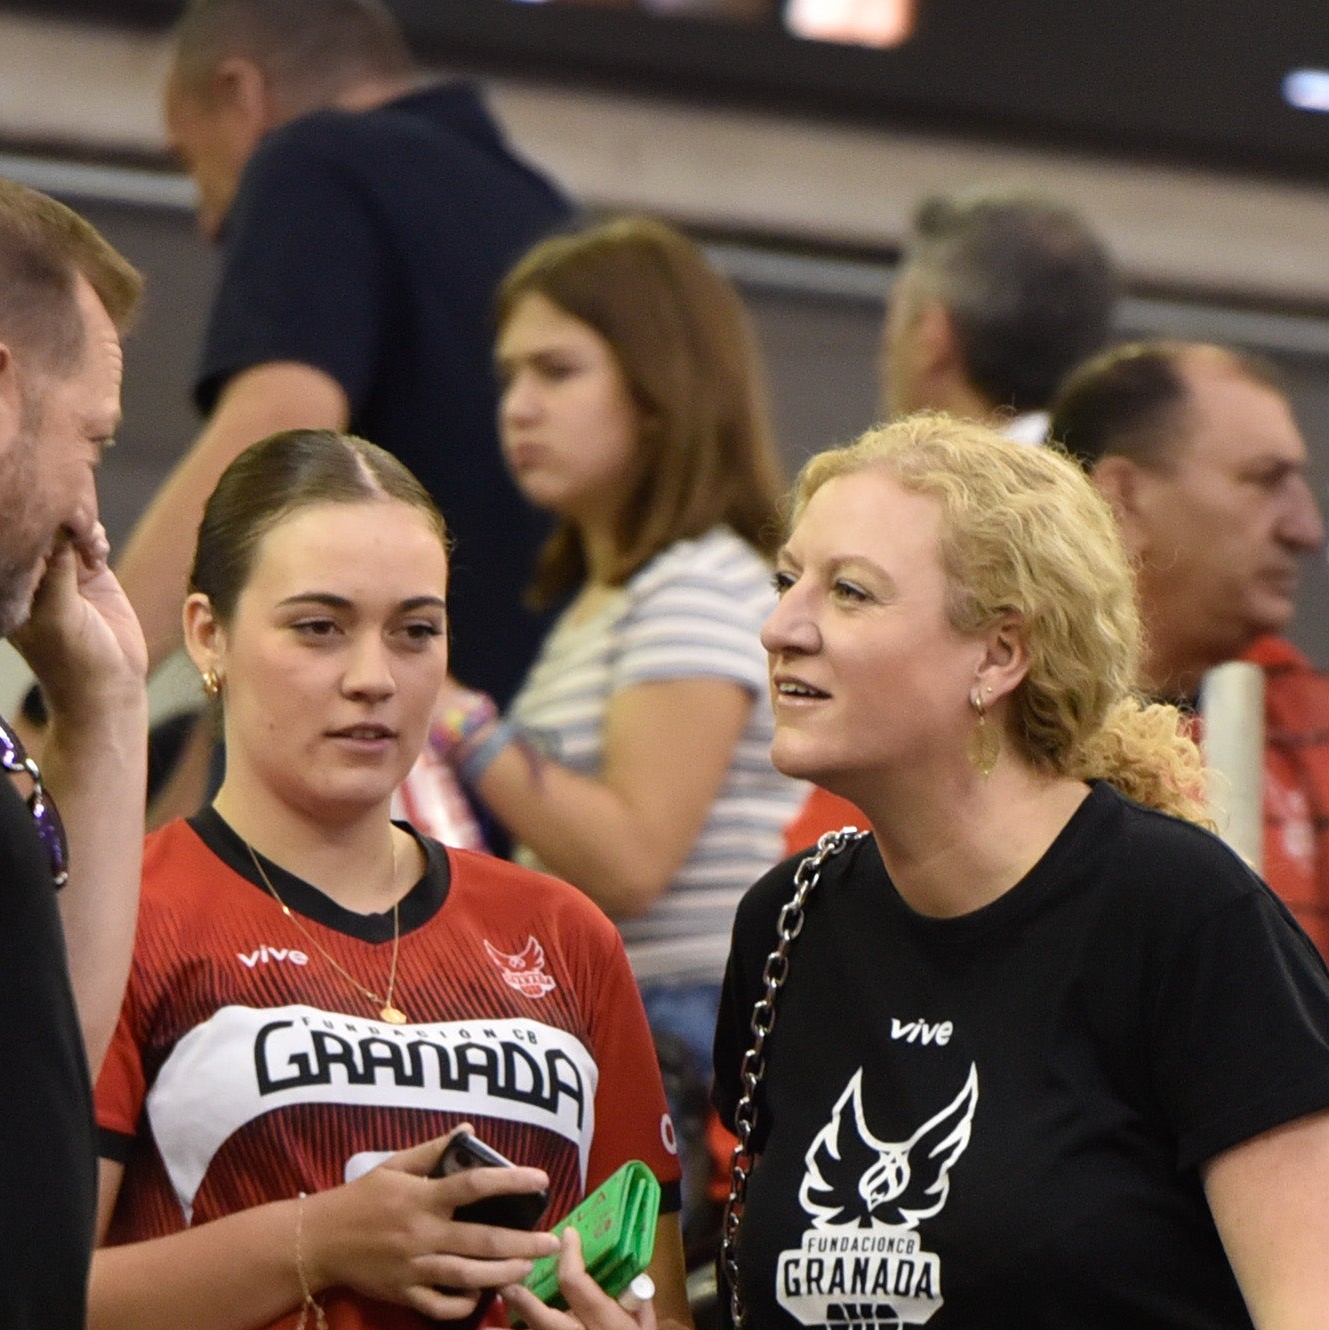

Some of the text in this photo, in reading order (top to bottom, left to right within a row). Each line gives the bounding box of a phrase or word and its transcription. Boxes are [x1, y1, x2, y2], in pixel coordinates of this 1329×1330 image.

[238, 944, 309, 968] vive
[513, 1028, 538, 1045] CB
[891, 1018, 953, 1046] vive
[254, 1020, 583, 1131] GRANADA
[783, 1256, 934, 1299] GRANADA
